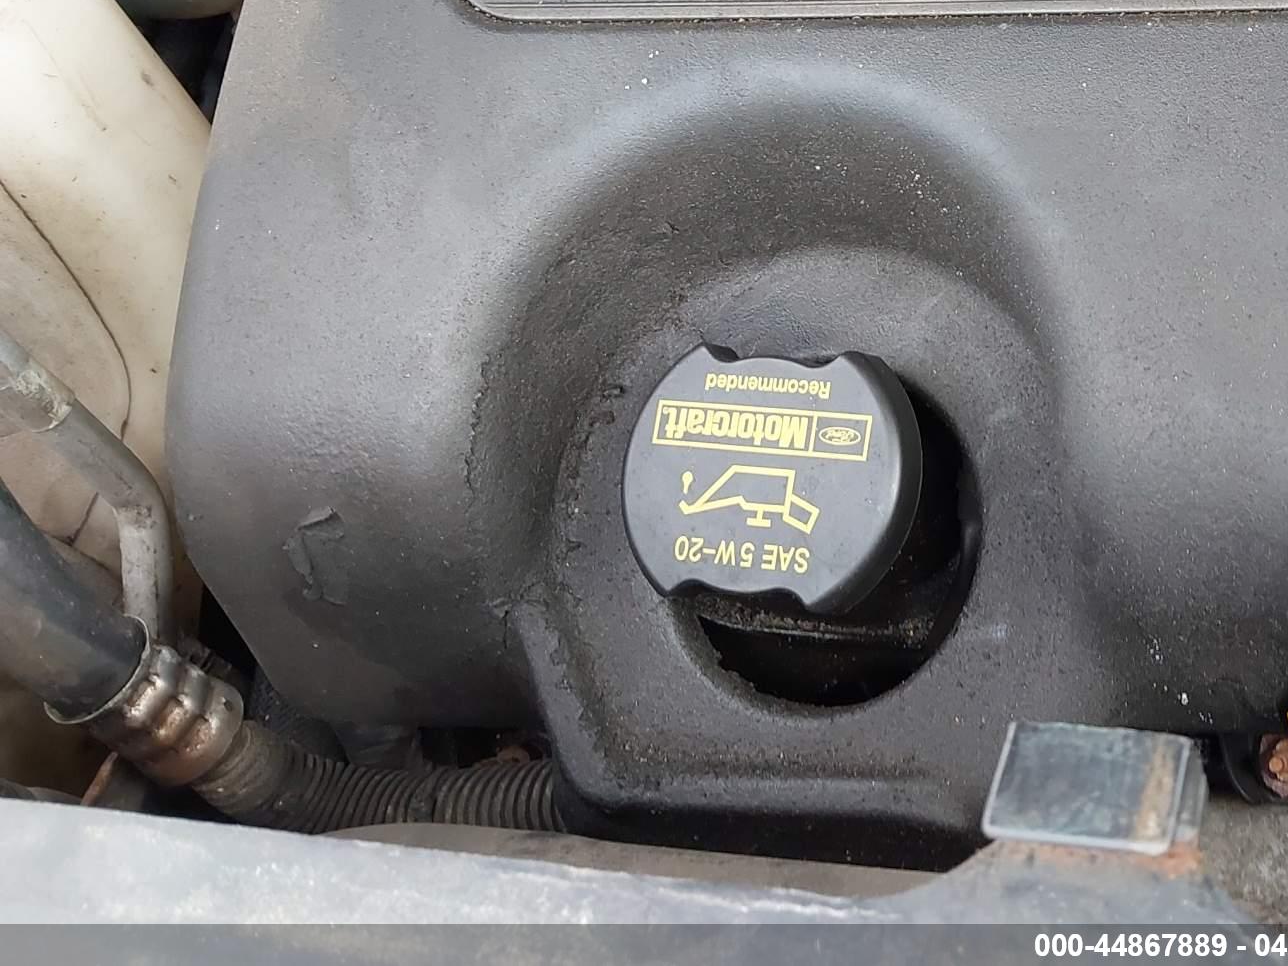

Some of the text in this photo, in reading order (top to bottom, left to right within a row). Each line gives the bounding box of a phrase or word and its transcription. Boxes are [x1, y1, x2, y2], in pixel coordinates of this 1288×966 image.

[705, 373, 831, 399] Recommended
[664, 408, 808, 449] Motorcraft
[762, 546, 810, 573] SAE
